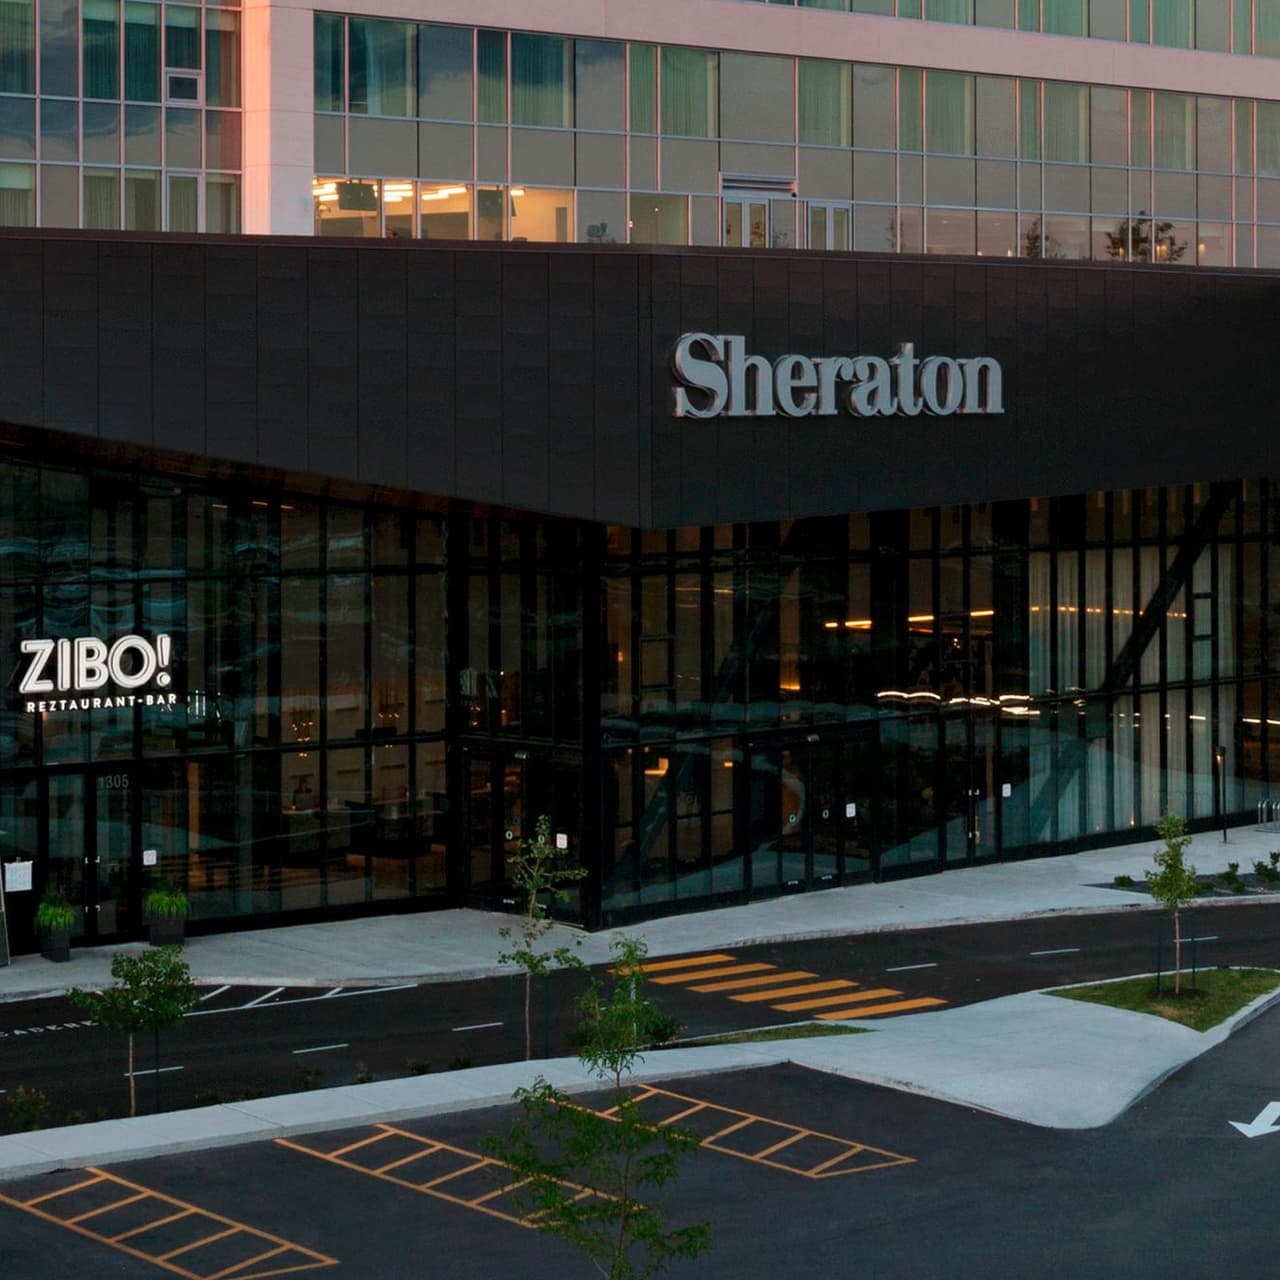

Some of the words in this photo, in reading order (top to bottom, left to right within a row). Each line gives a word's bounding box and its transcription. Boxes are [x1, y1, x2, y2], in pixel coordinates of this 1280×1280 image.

[672, 331, 1005, 419] Sheraton
[19, 633, 172, 694] ZIBO!
[26, 693, 177, 713] REZTAURANT-BAR
[97, 774, 129, 789] 1305
